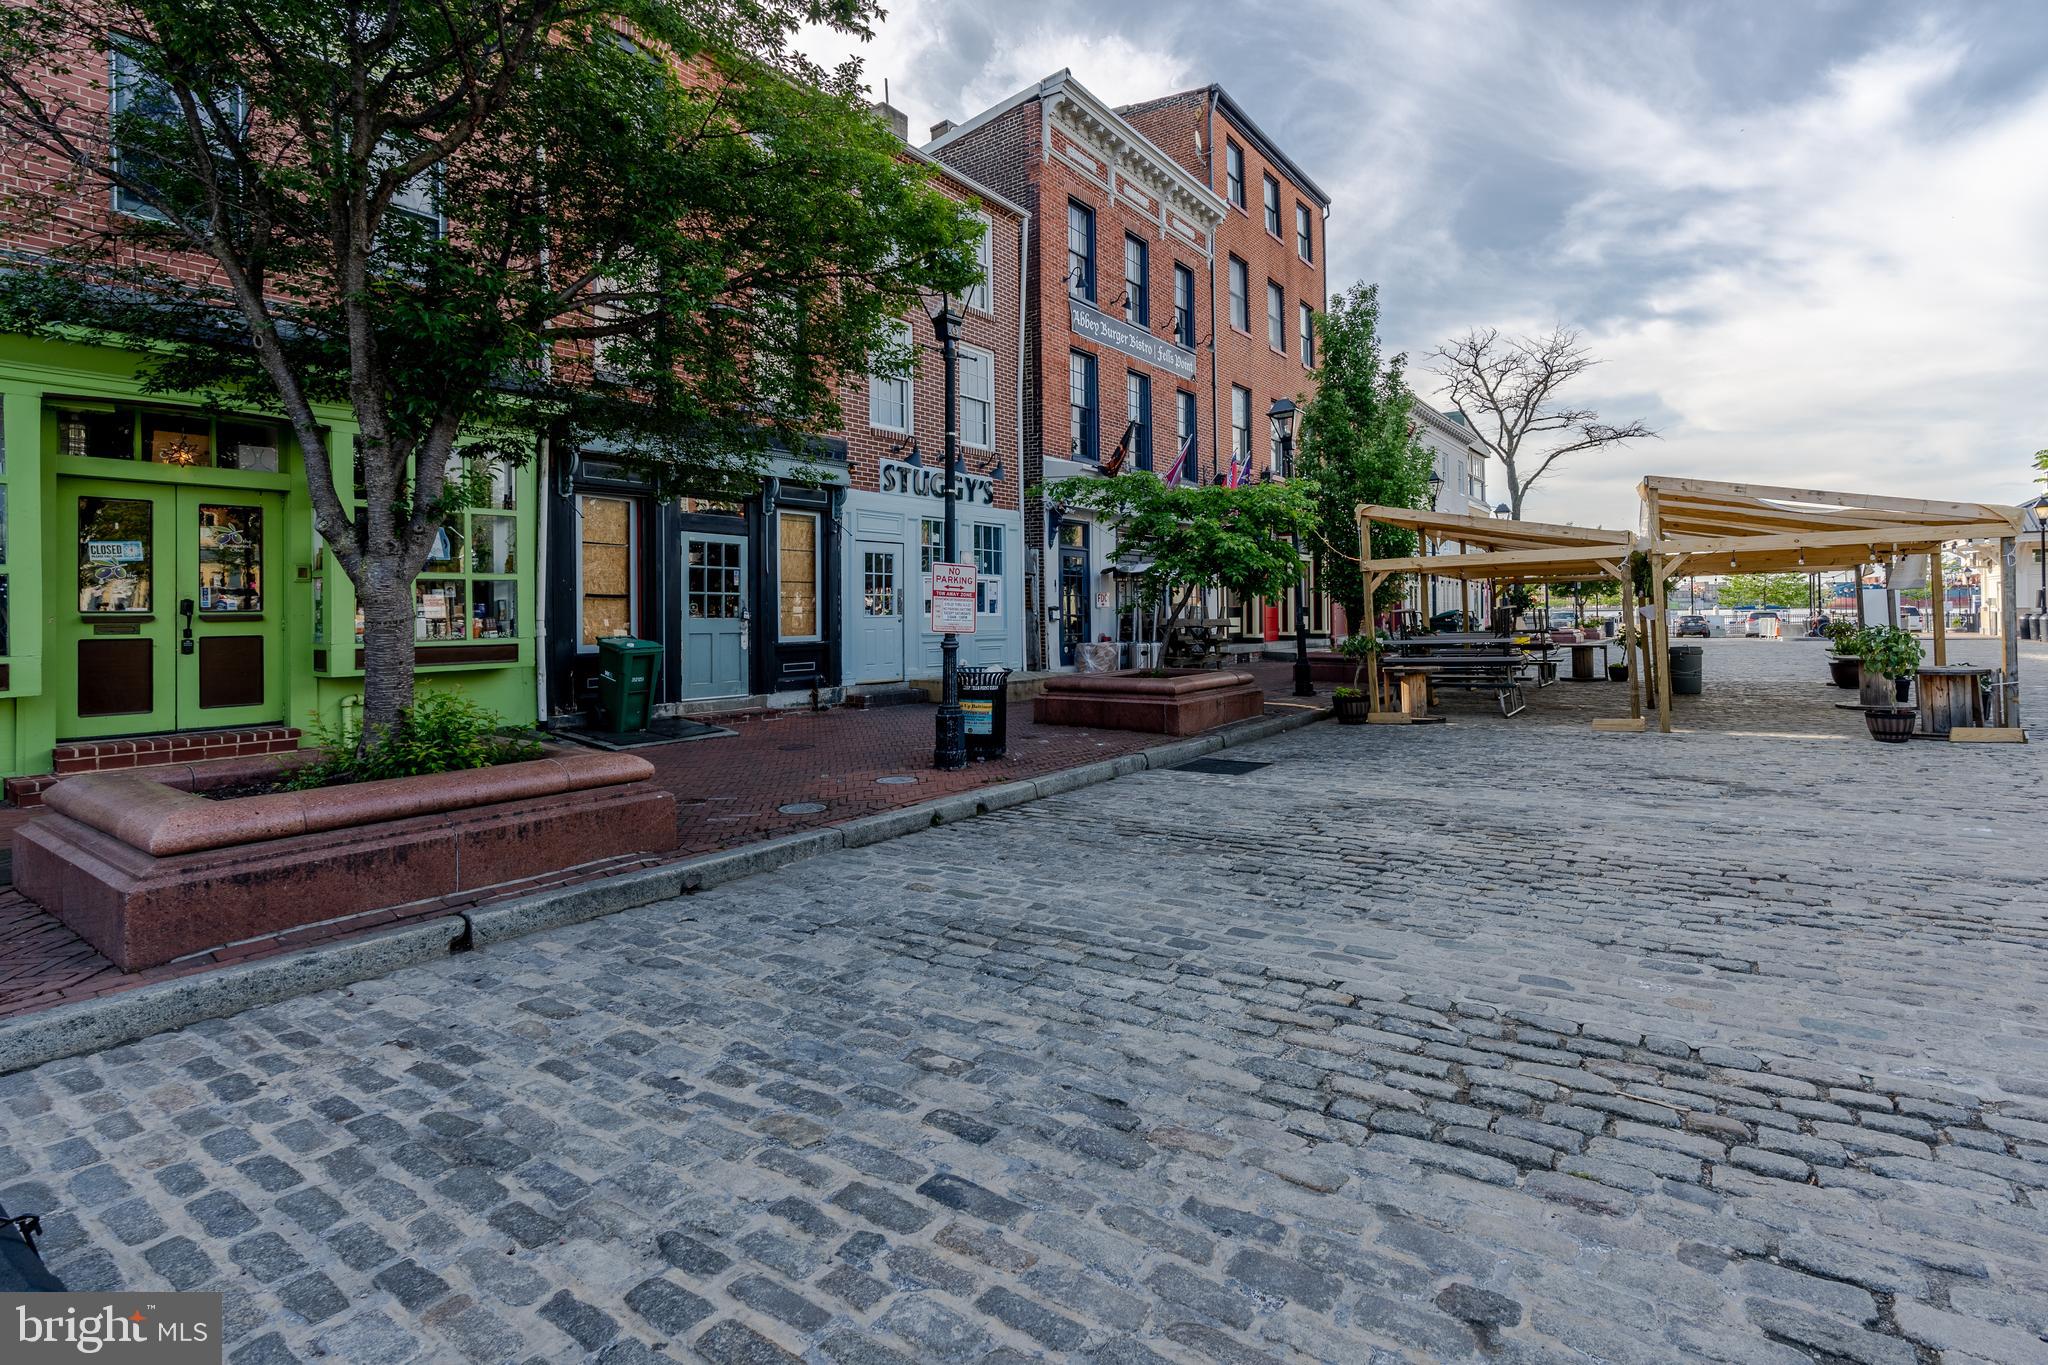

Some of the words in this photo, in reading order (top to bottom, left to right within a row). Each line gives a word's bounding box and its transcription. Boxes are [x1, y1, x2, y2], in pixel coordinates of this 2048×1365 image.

[1073, 309, 1099, 336] Abbey
[1100, 320, 1128, 345] Burger
[1128, 334, 1153, 355] Bistro
[1174, 354, 1194, 373] Point
[883, 464, 993, 505] STUGGY'S
[90, 544, 122, 555] CLOSED
[936, 576, 973, 585] PARKING
